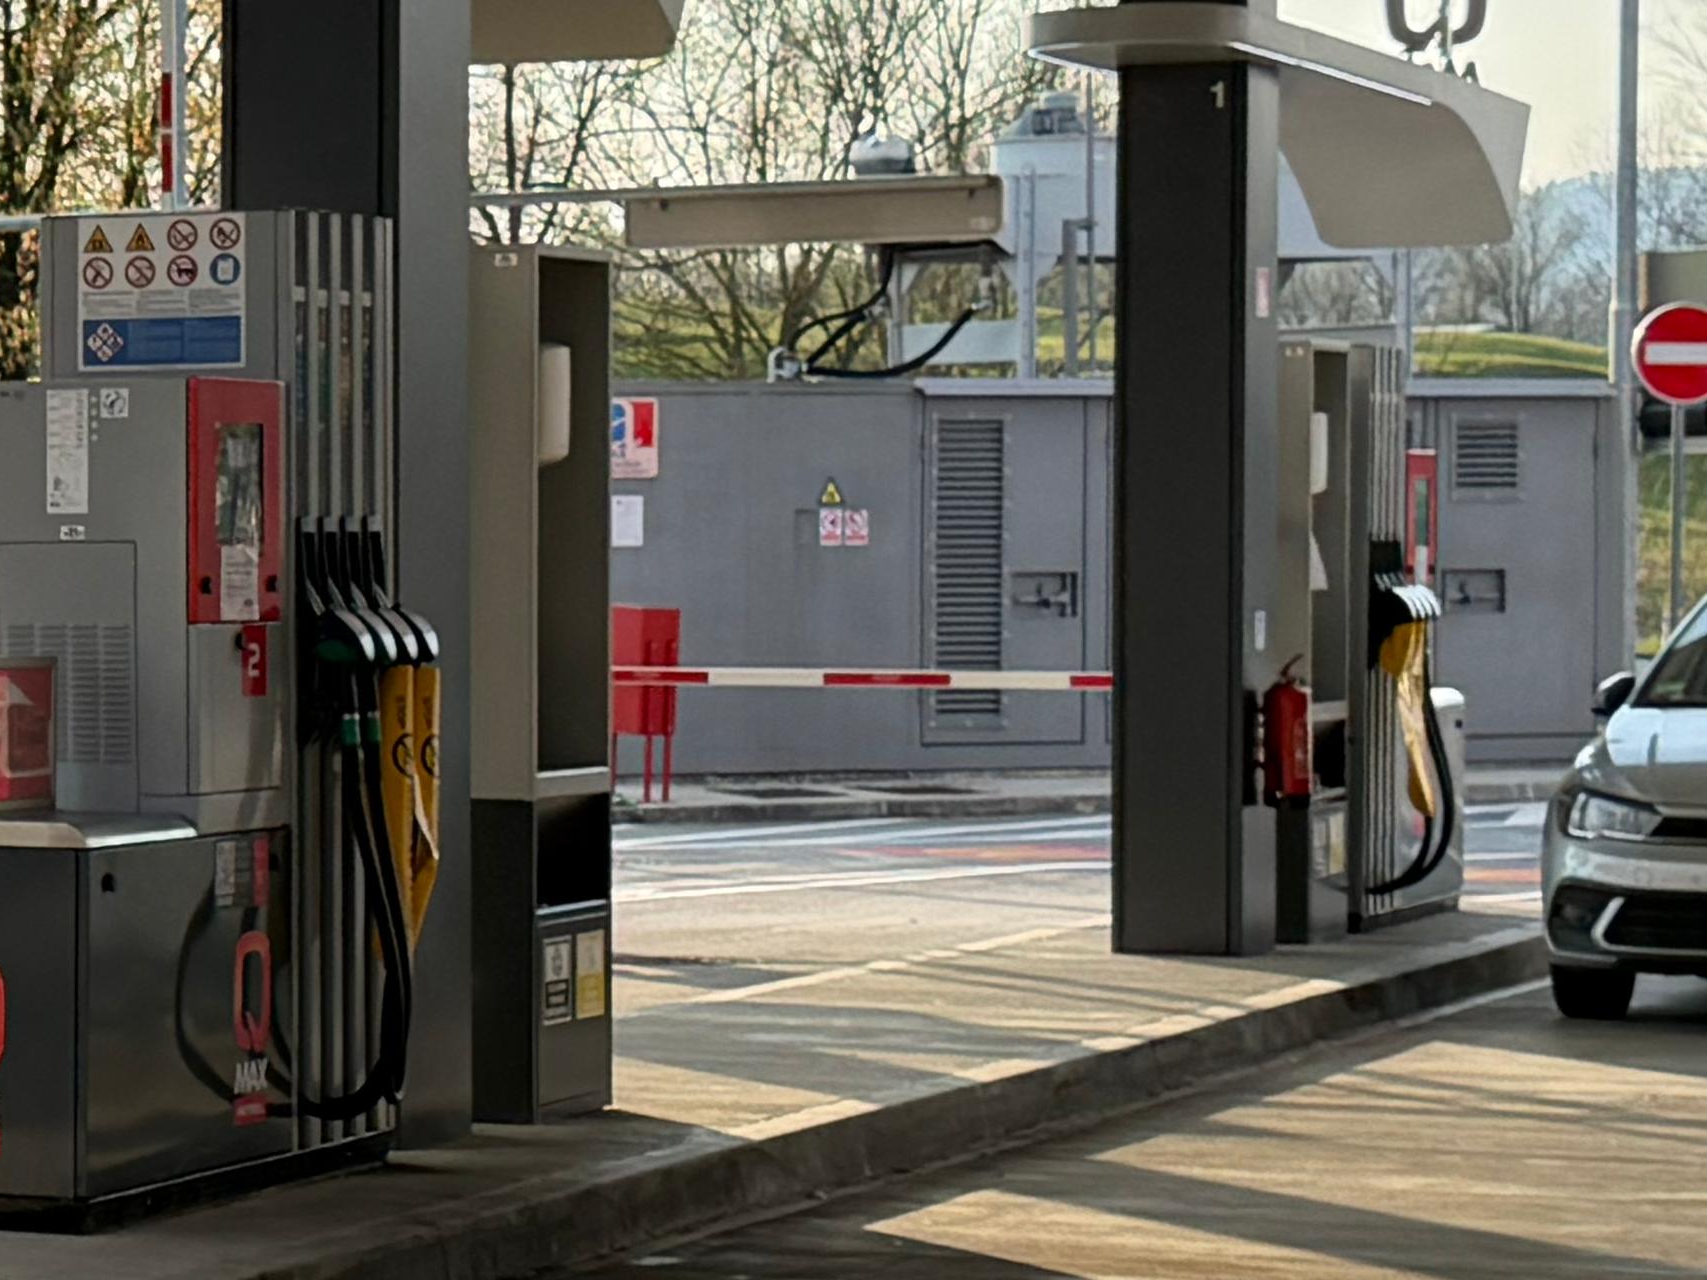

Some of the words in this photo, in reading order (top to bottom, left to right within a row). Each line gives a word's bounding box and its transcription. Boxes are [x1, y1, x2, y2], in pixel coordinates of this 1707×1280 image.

[1209, 80, 1225, 108] 1
[247, 642, 261, 678] 2
[234, 930, 271, 1053] Q
[234, 1057, 268, 1095] MAX
